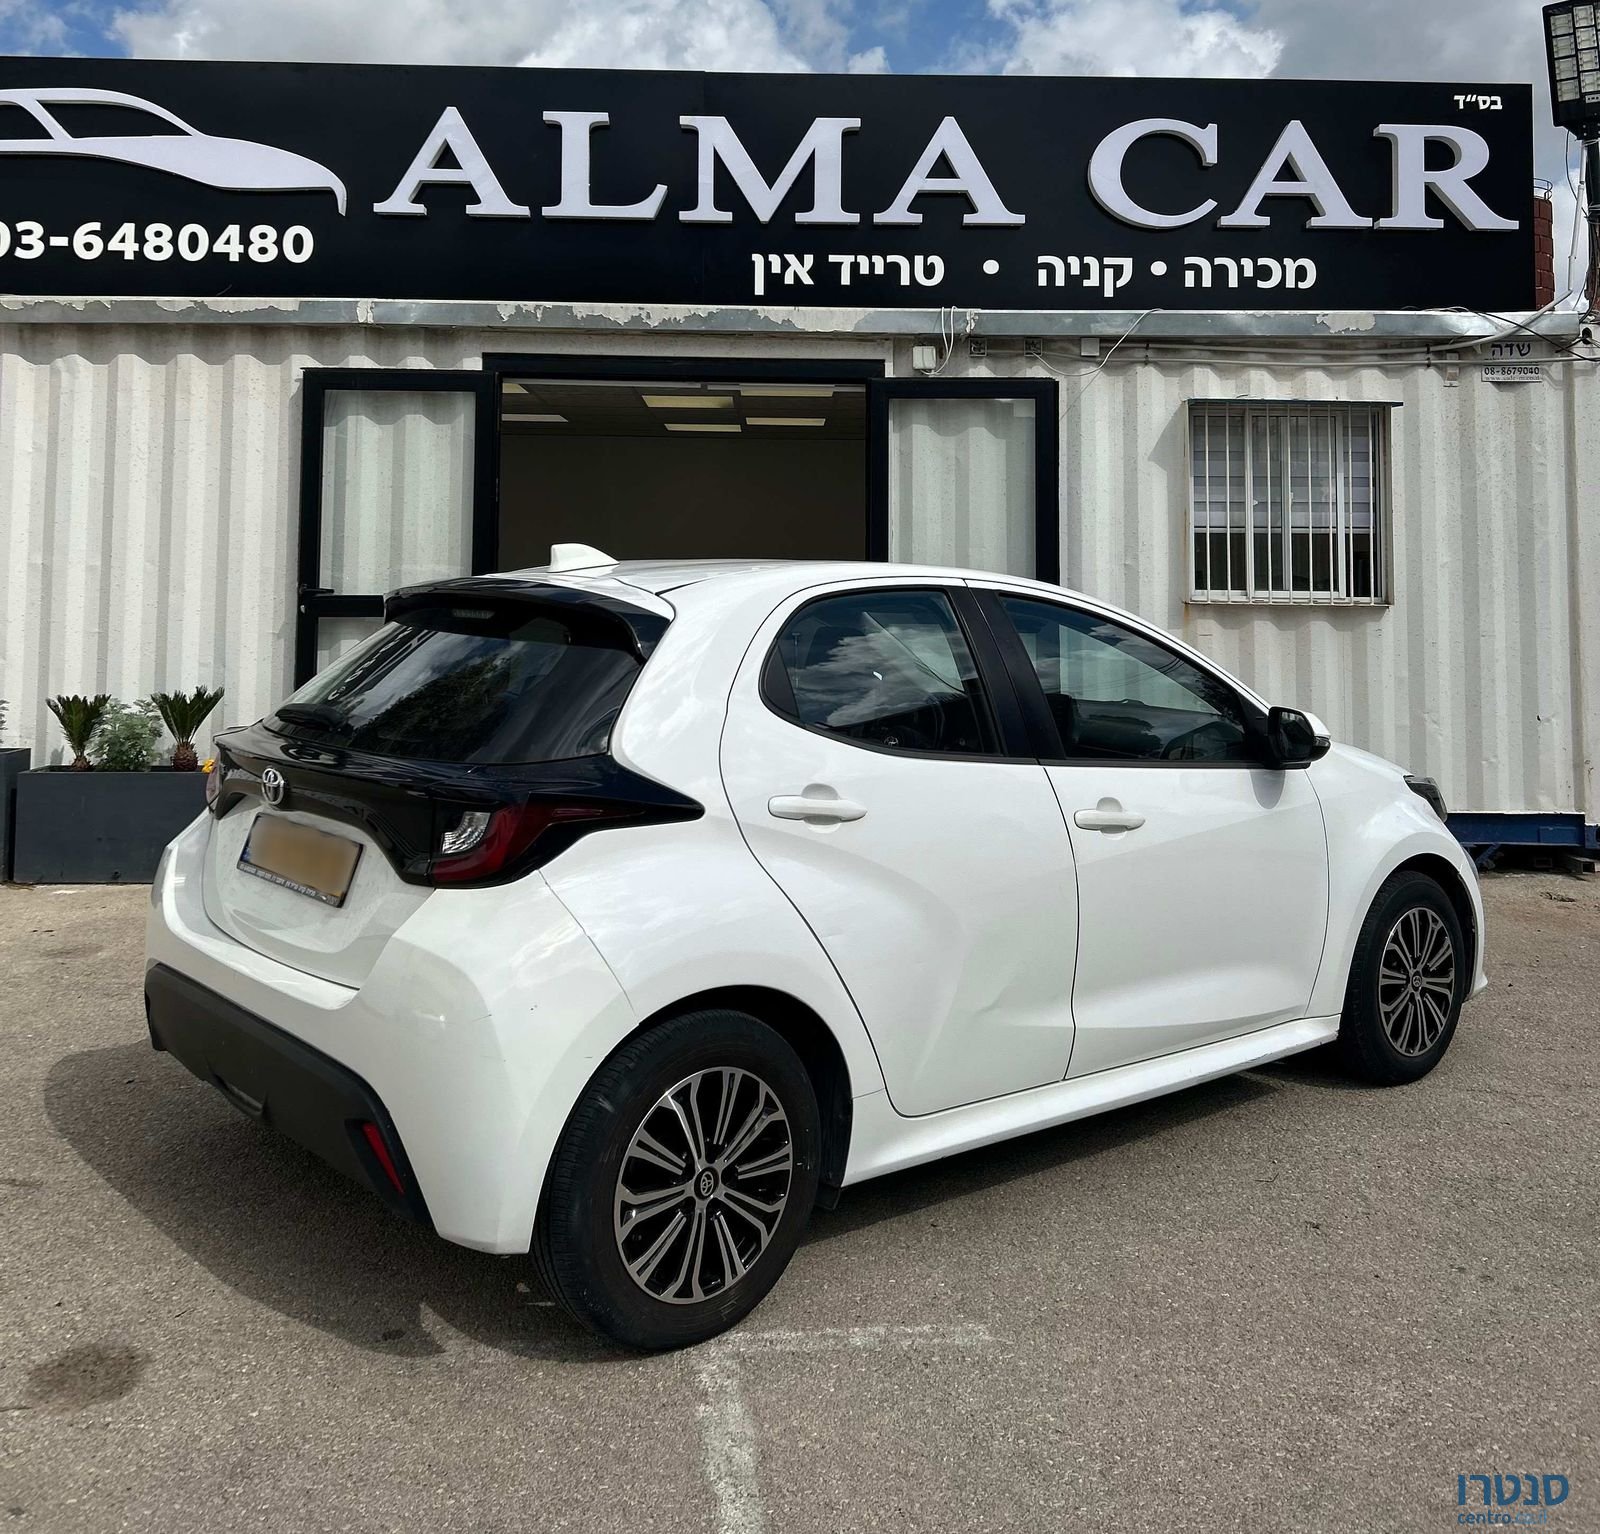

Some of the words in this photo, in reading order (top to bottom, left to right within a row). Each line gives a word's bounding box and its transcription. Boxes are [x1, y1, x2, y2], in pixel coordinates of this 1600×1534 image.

[373, 106, 1026, 225] ALMA
[1087, 117, 1520, 231] CAR
[751, 253, 815, 296] אין
[828, 254, 945, 287] טרייד
[1037, 255, 1133, 298] קניה
[1183, 256, 1317, 290] מכירה
[1491, 343, 1531, 357] שדה
[1484, 366, 1540, 376] 08-8679040
